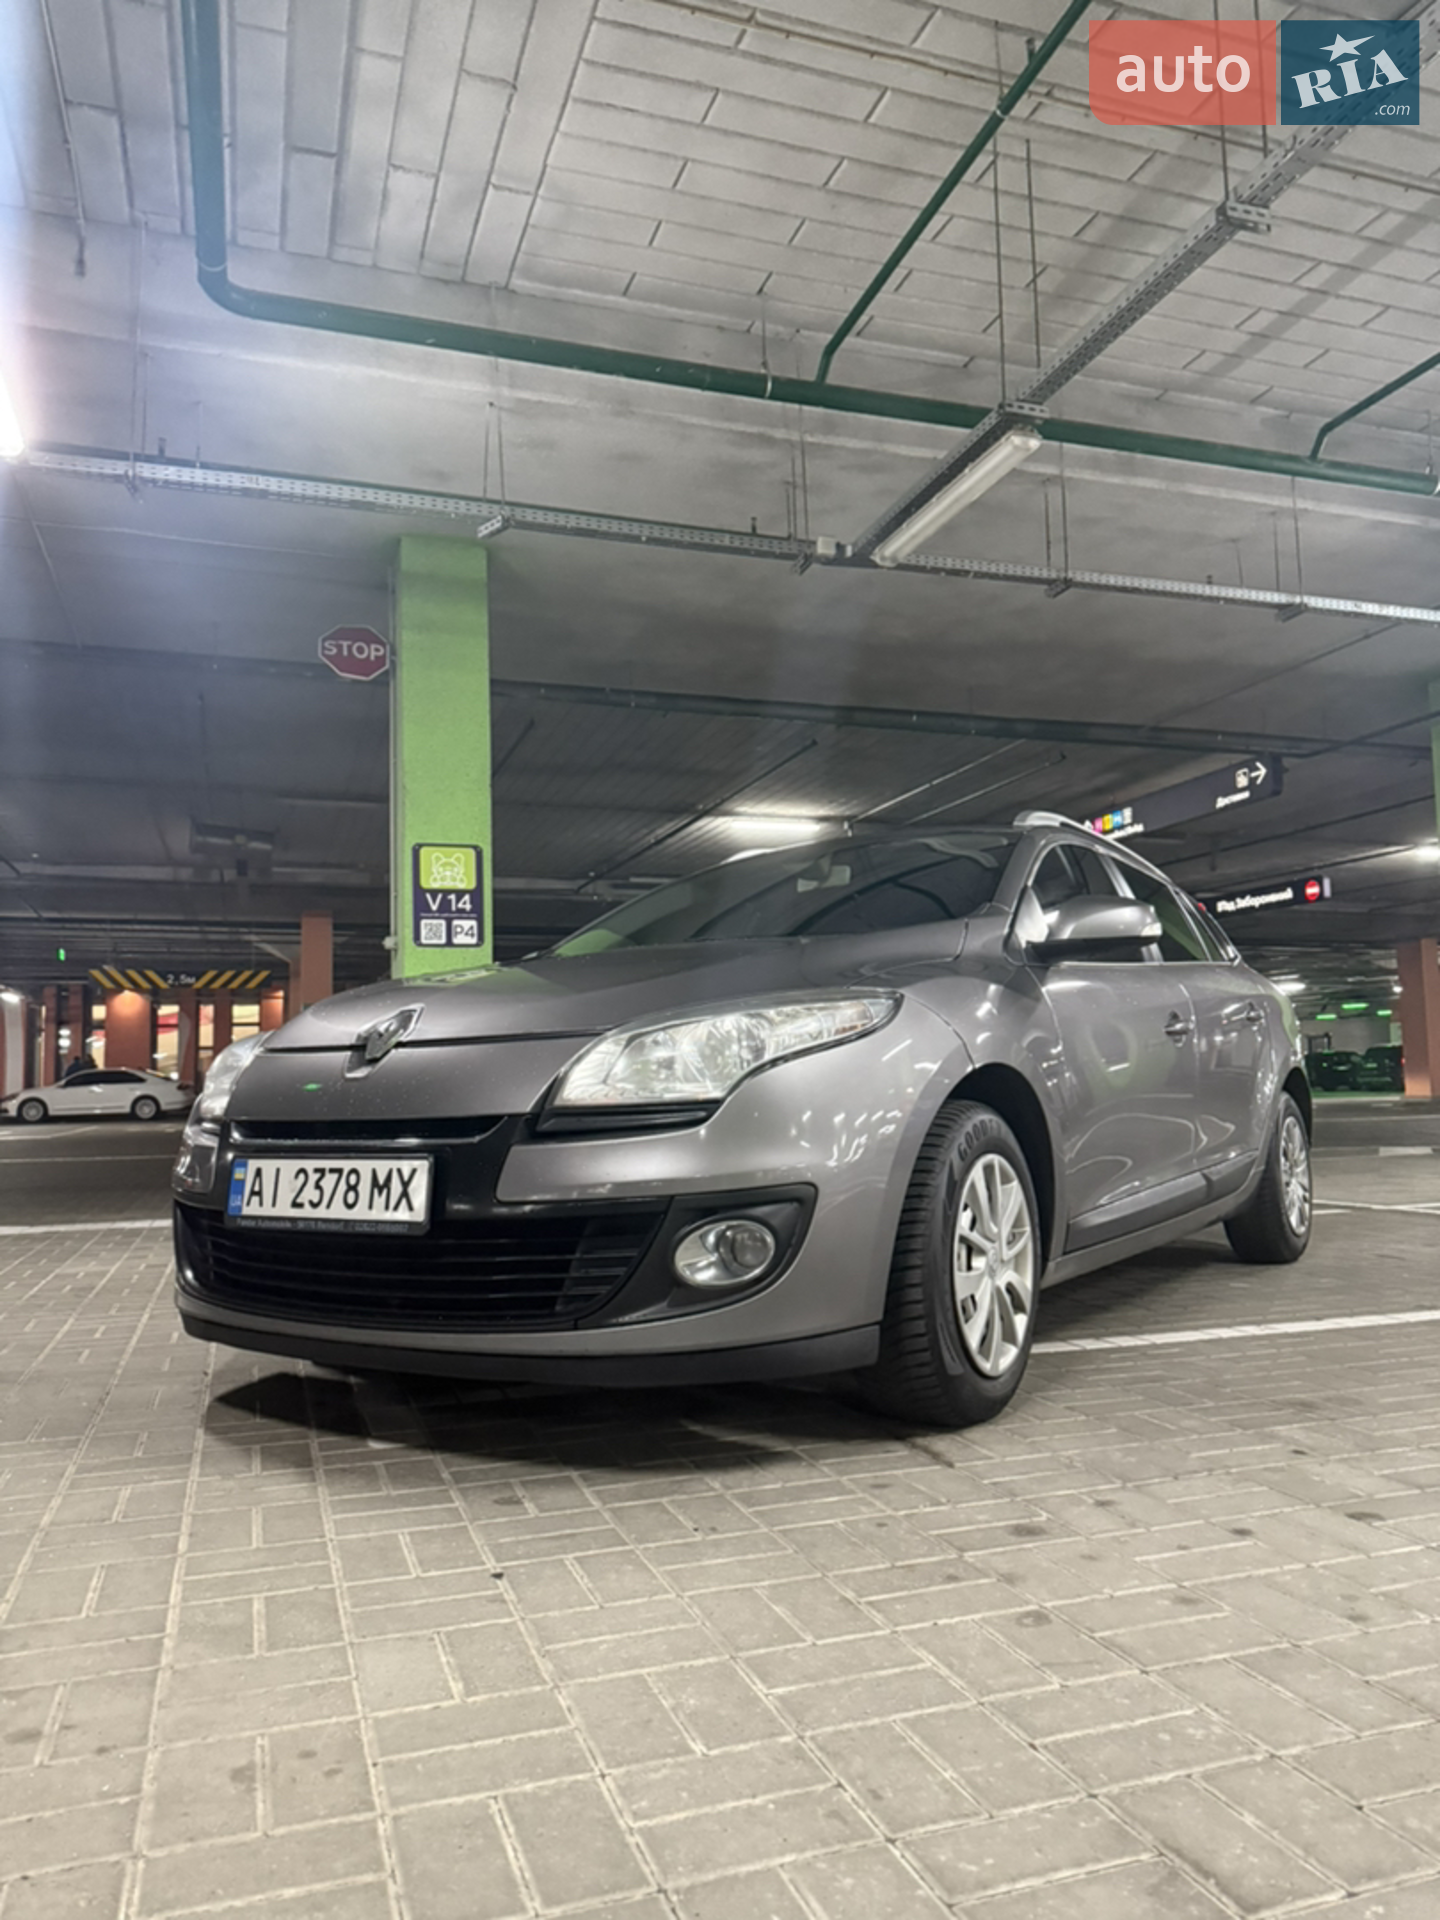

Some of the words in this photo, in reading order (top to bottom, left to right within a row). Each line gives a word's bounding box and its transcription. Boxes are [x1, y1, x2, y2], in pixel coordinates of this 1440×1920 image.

[323, 640, 385, 660] STOP
[425, 893, 443, 912] V
[447, 893, 473, 912] 14
[454, 924, 475, 939] P4
[246, 1167, 281, 1208] AI
[290, 1167, 361, 1210] 2378
[368, 1167, 417, 1213] MX
